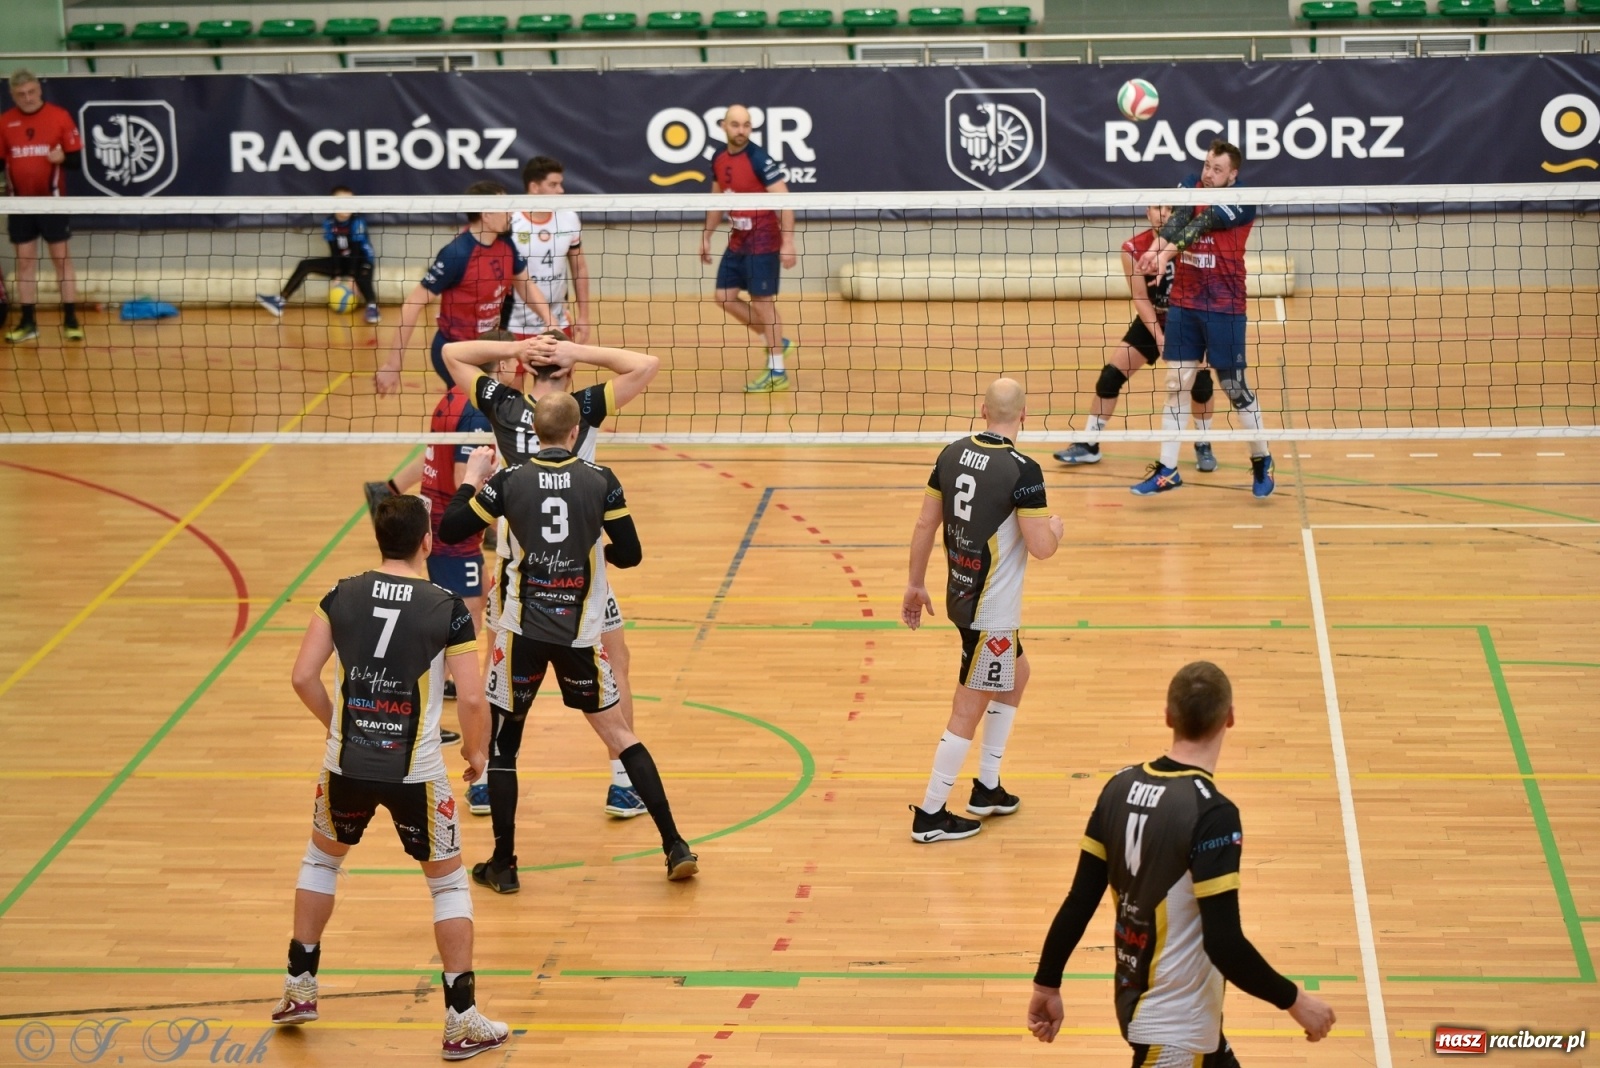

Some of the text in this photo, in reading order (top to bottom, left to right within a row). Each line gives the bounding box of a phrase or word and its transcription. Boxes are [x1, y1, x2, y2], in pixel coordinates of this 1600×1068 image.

[229, 113, 519, 173] RACIBÓRZ
[1104, 102, 1405, 162] RACIBÓRZ
[541, 249, 553, 267] 4
[959, 448, 990, 471] ENTER
[538, 472, 571, 490] ENTER
[953, 473, 977, 522] 2
[541, 496, 569, 544] 3
[465, 562, 479, 587] 3
[372, 580, 413, 602] ENTER
[372, 606, 401, 659] 7
[488, 670, 498, 692] 3
[987, 661, 1002, 682] 2
[355, 719, 403, 731] GRAVTON
[1126, 781, 1166, 808] ENTER
[447, 824, 455, 847] 7
